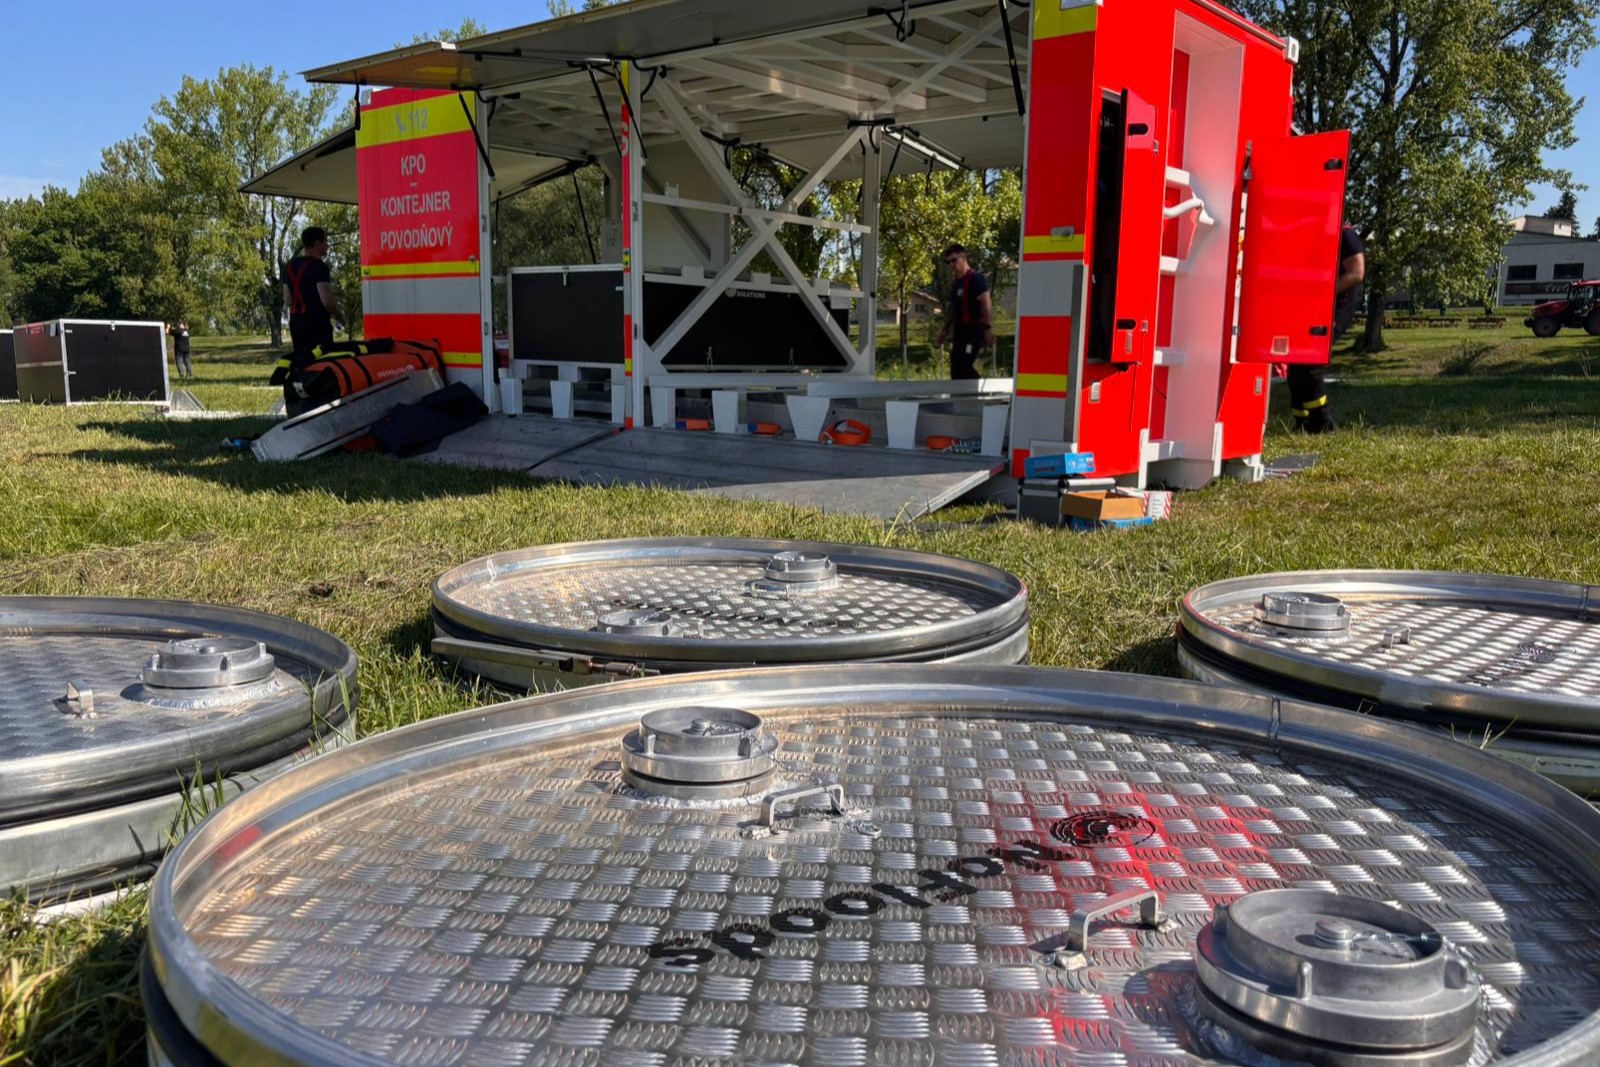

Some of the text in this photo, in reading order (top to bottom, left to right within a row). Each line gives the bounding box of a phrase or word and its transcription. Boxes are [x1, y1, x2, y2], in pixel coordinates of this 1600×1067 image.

[408, 108, 428, 131] 112
[401, 153, 426, 176] KPO
[380, 191, 451, 217] KONTEJNER
[380, 220, 454, 250] POVODŇOVÝ
